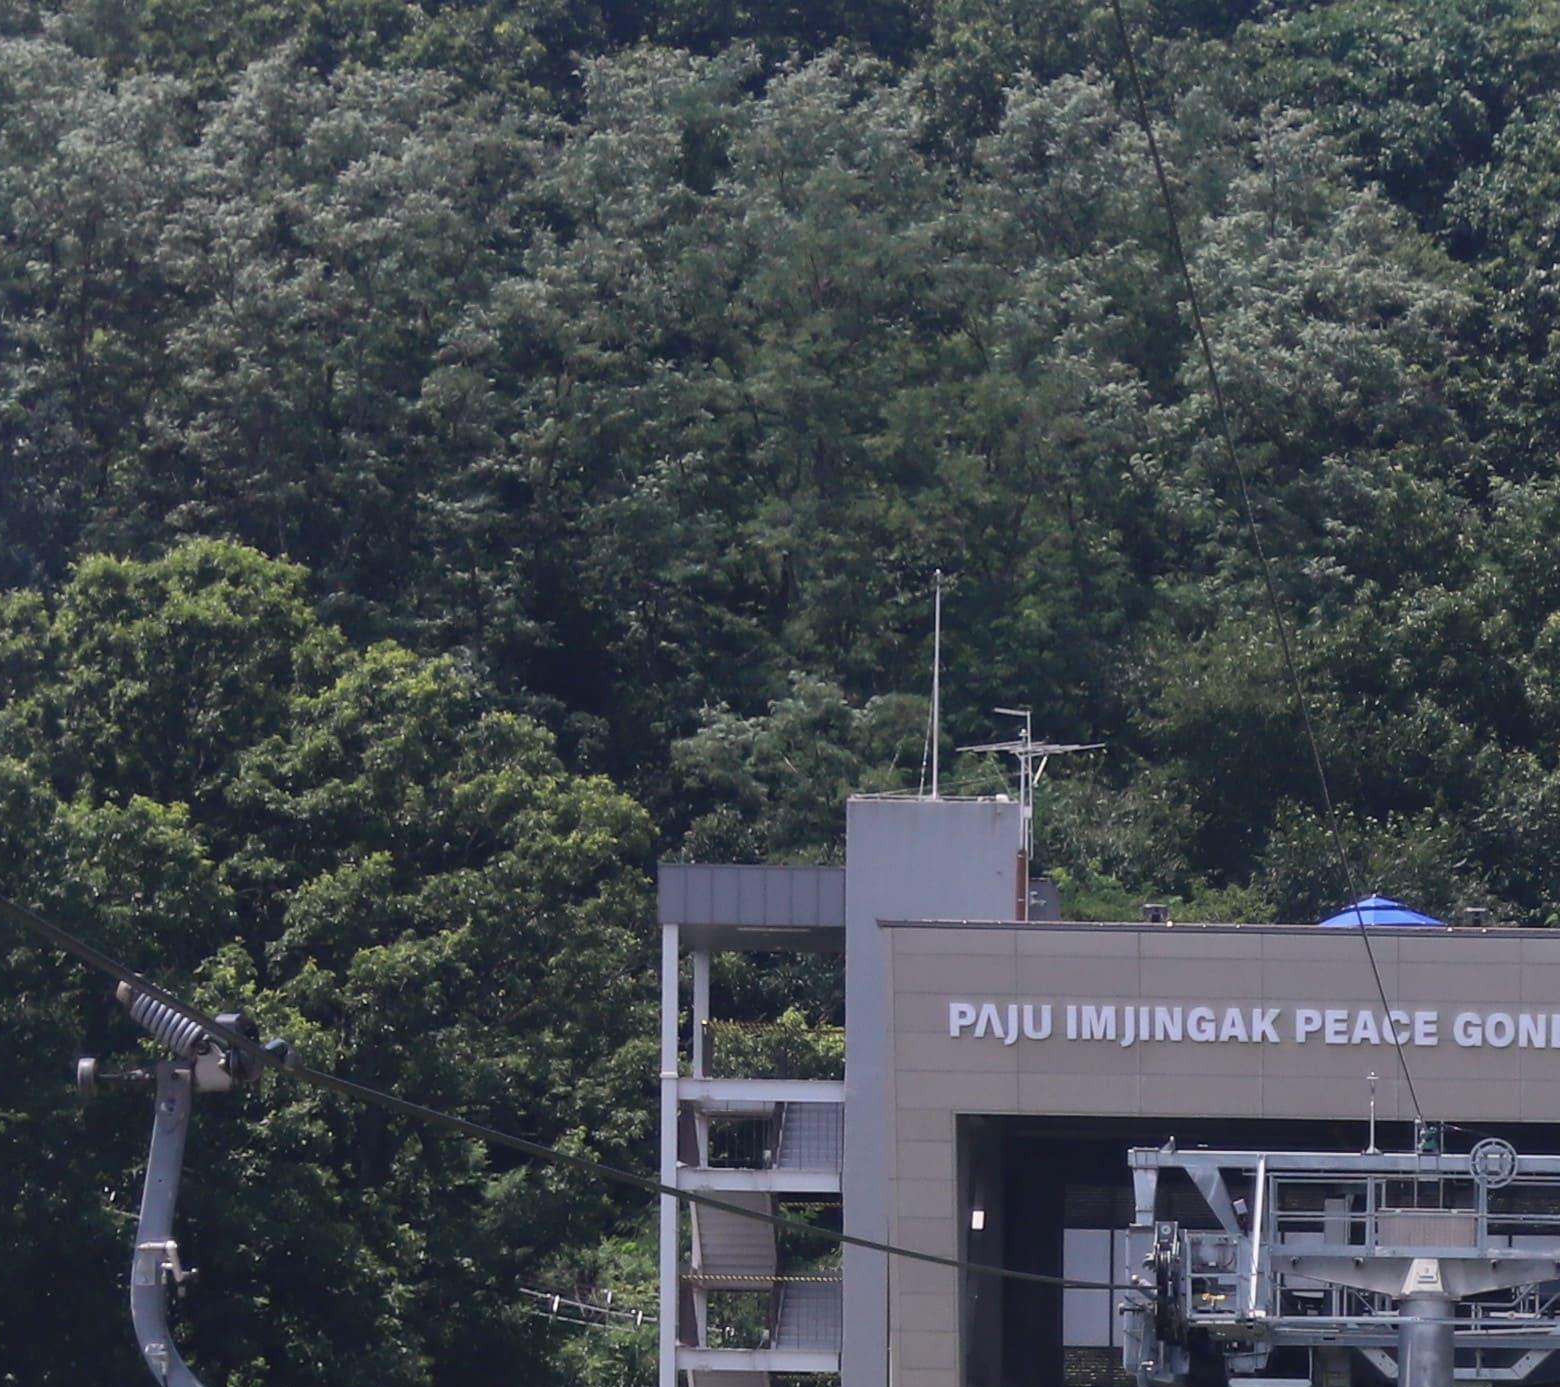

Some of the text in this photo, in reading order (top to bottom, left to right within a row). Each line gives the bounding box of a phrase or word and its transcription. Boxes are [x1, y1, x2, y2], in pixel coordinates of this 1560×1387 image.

[948, 1002, 1053, 1046] PAJU
[1066, 1004, 1281, 1047] IMJINGAK
[1295, 1008, 1439, 1047] PEACE
